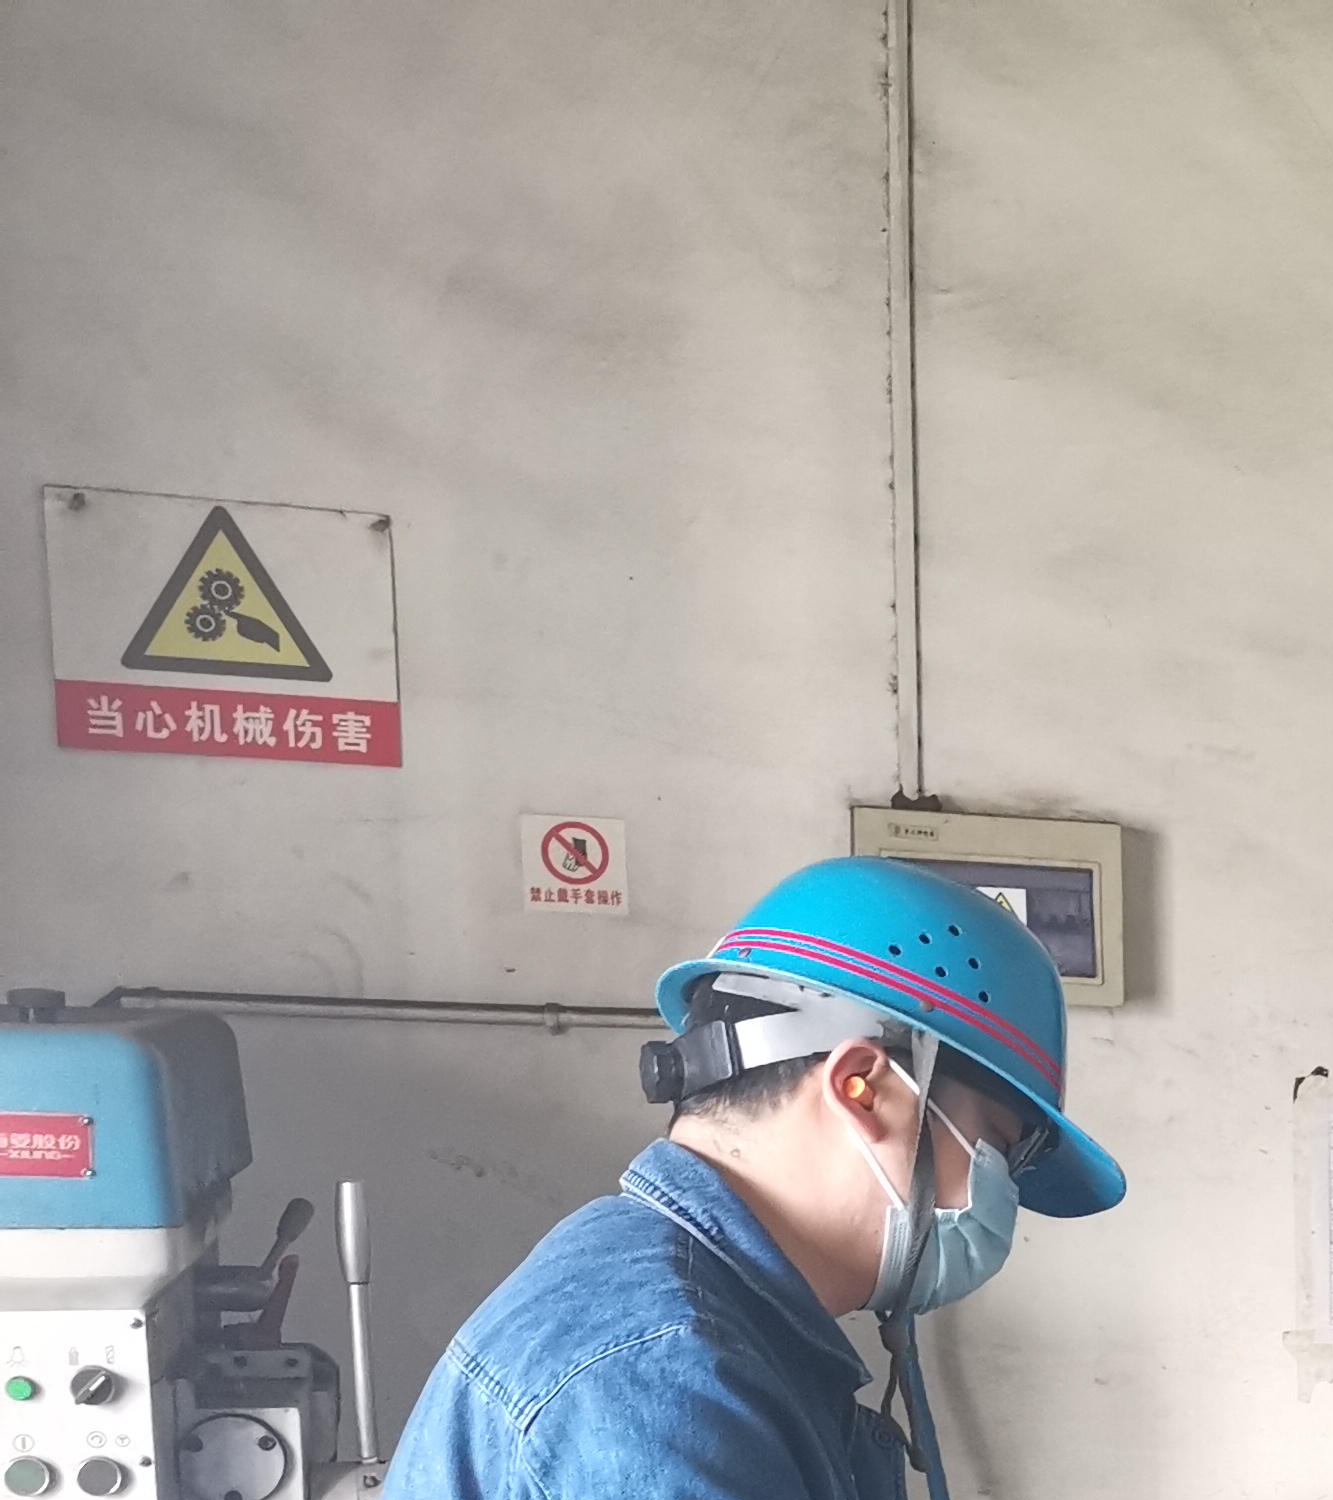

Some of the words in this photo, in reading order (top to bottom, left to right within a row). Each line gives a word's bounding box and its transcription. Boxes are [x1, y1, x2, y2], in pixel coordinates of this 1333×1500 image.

[86, 694, 372, 754] 当心机械伤害
